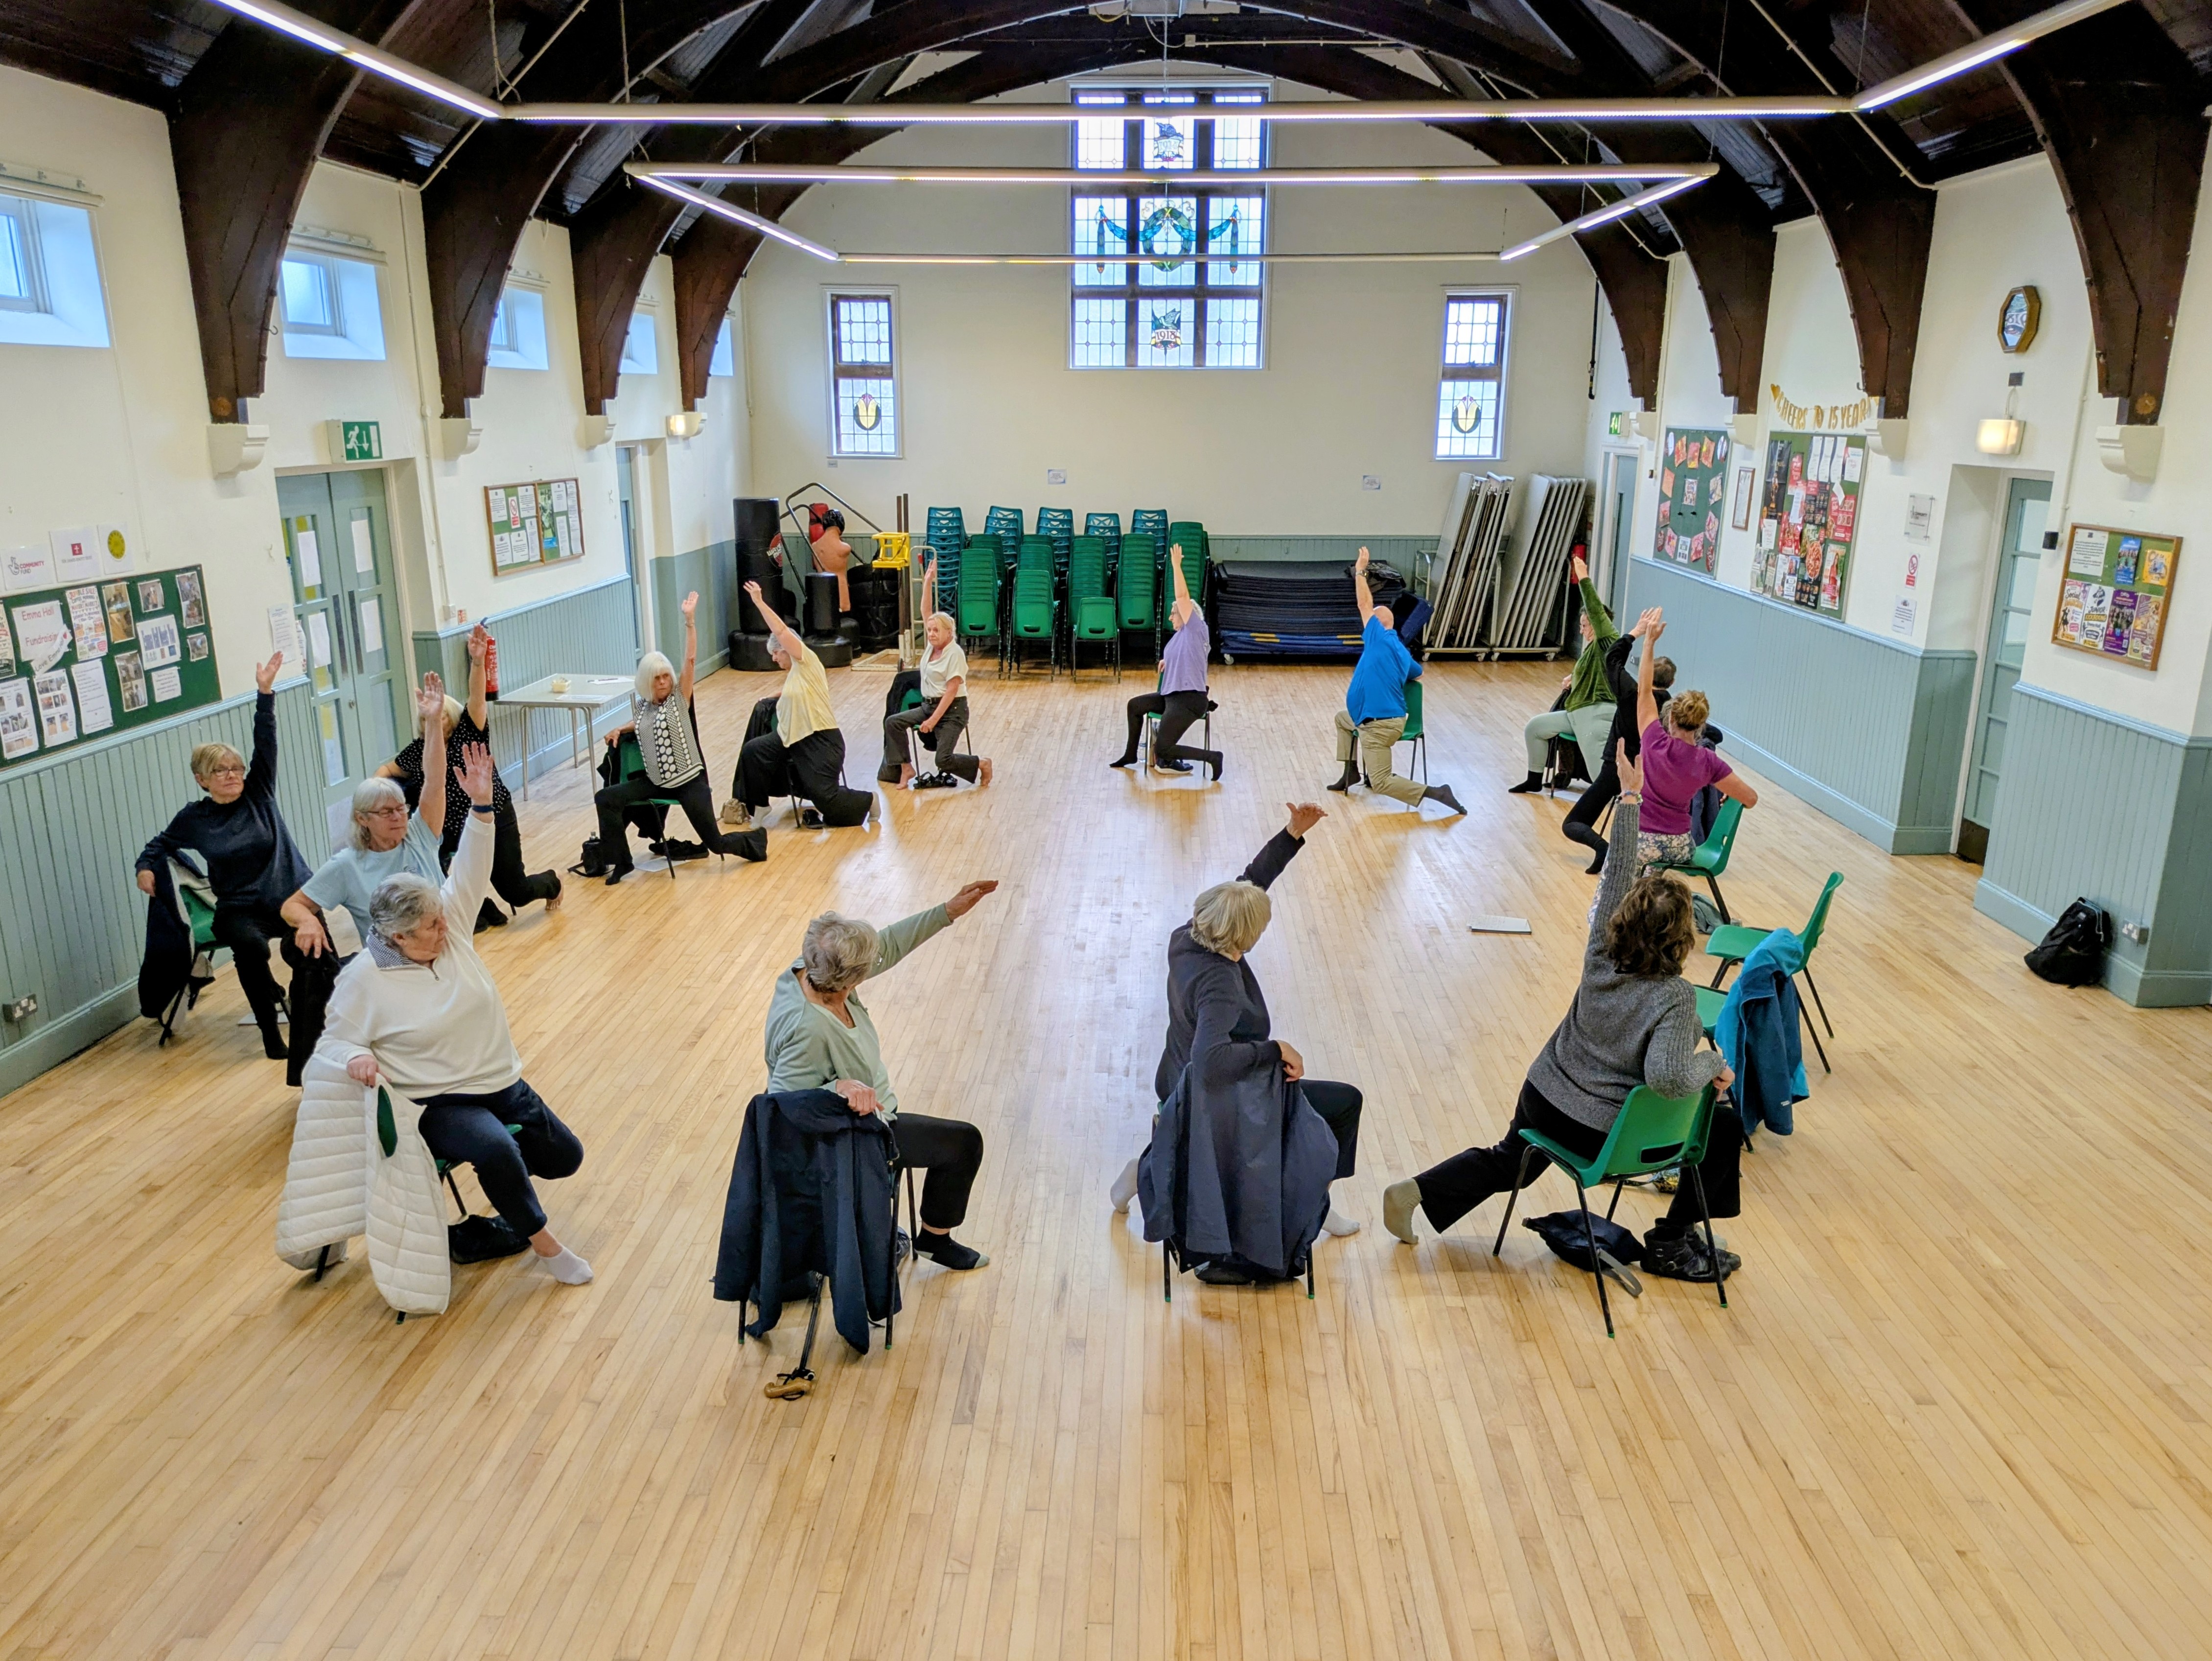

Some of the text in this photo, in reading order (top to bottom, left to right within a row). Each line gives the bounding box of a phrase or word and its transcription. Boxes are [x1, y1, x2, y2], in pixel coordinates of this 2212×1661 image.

[1156, 330, 1176, 341] 1918
[1776, 391, 1808, 430] CHEERS
[1828, 405, 1839, 430] 15
[20, 561, 44, 569] COMMUNITY
[2065, 588, 2081, 599] Social
[21, 607, 54, 621] Emma Hall
[25, 632, 59, 646] Fundraisin
[35, 660, 47, 672] Love
[48, 647, 61, 662] Emma
